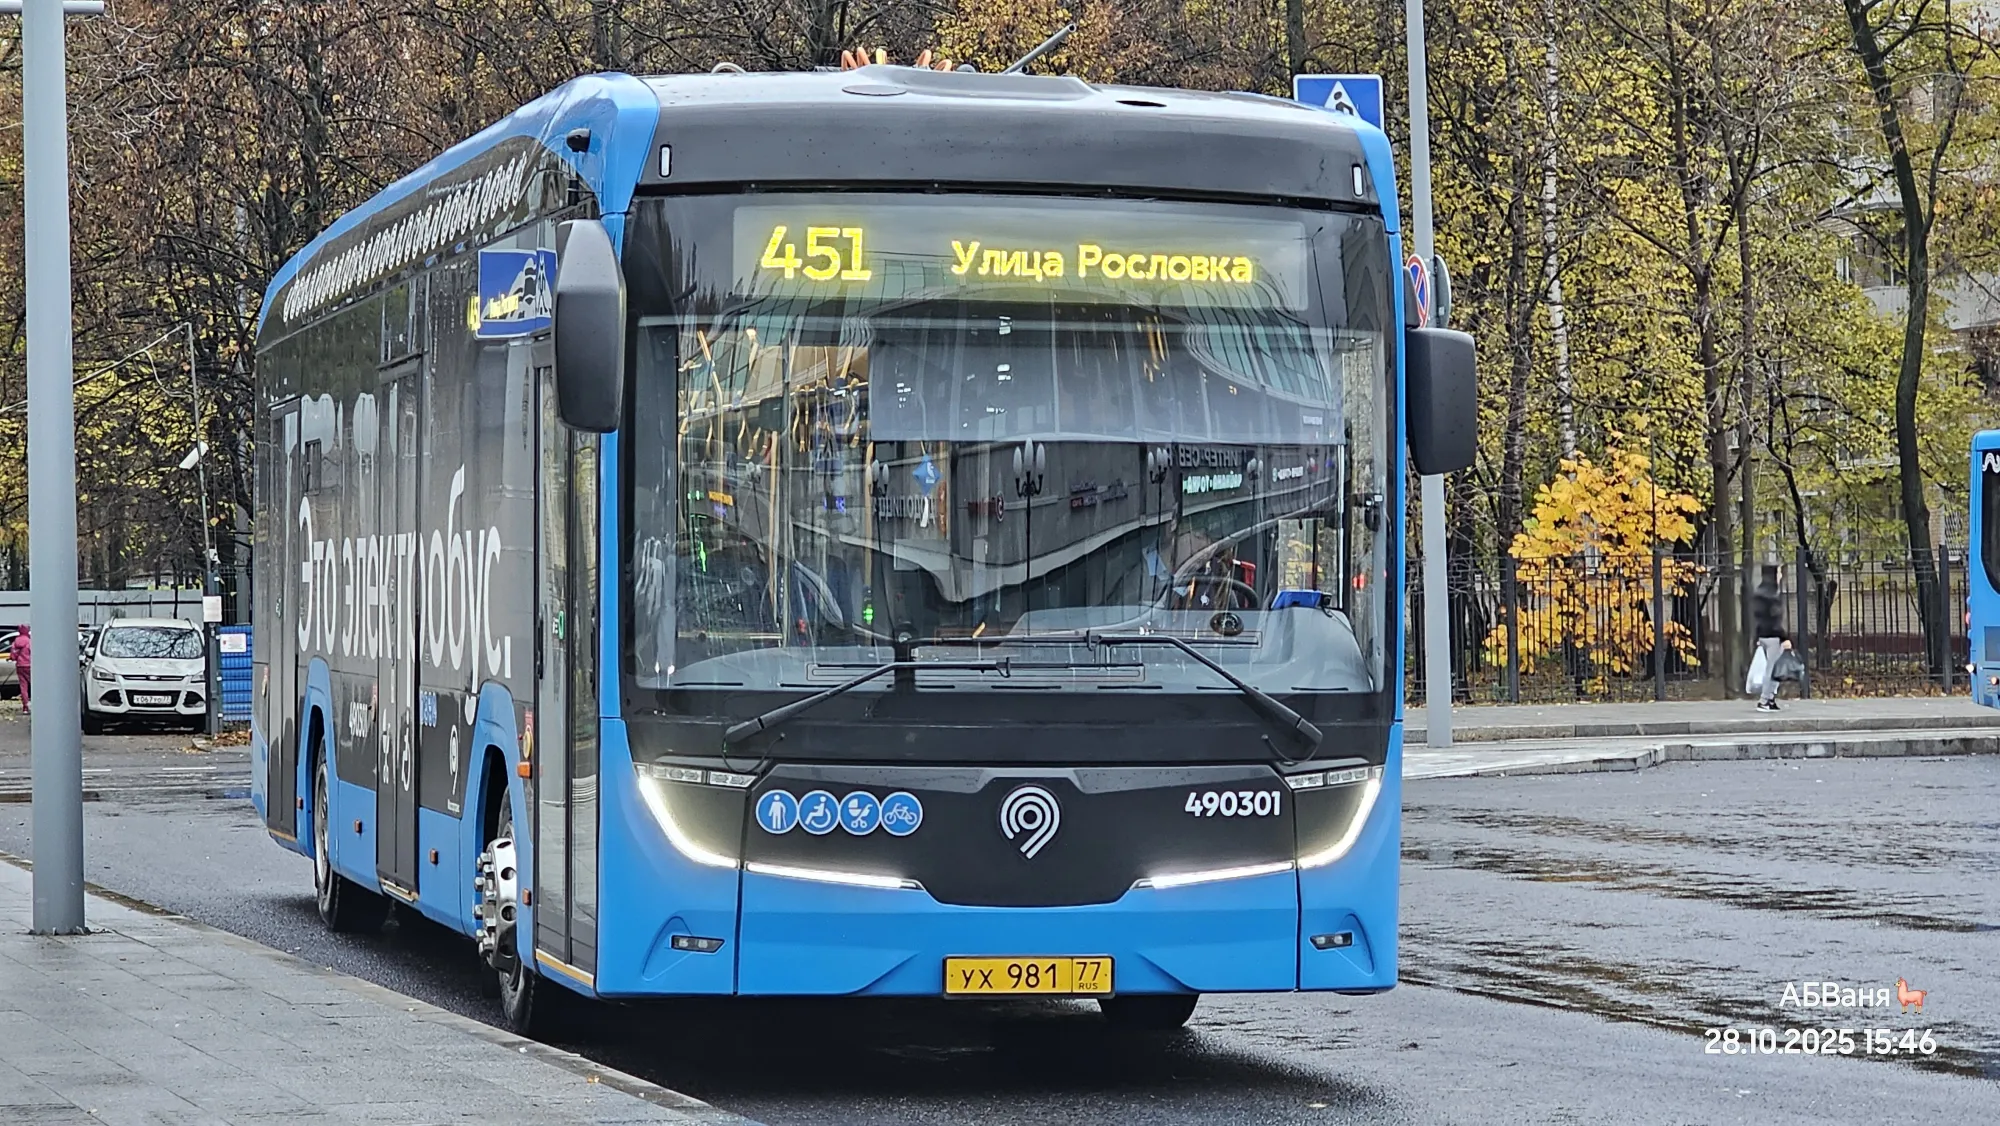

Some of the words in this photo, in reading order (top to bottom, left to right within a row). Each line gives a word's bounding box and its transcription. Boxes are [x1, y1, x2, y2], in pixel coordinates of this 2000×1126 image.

[761, 225, 872, 281] 451
[950, 240, 1064, 282] Улица
[1078, 244, 1254, 283] Рословка
[298, 496, 337, 655] Это
[342, 463, 512, 726] электробус.
[1184, 790, 1281, 817] 490301
[961, 969, 994, 989] УХ
[1007, 963, 1057, 989] 981
[1075, 961, 1102, 981] 77
[1078, 982, 1099, 990] RUS
